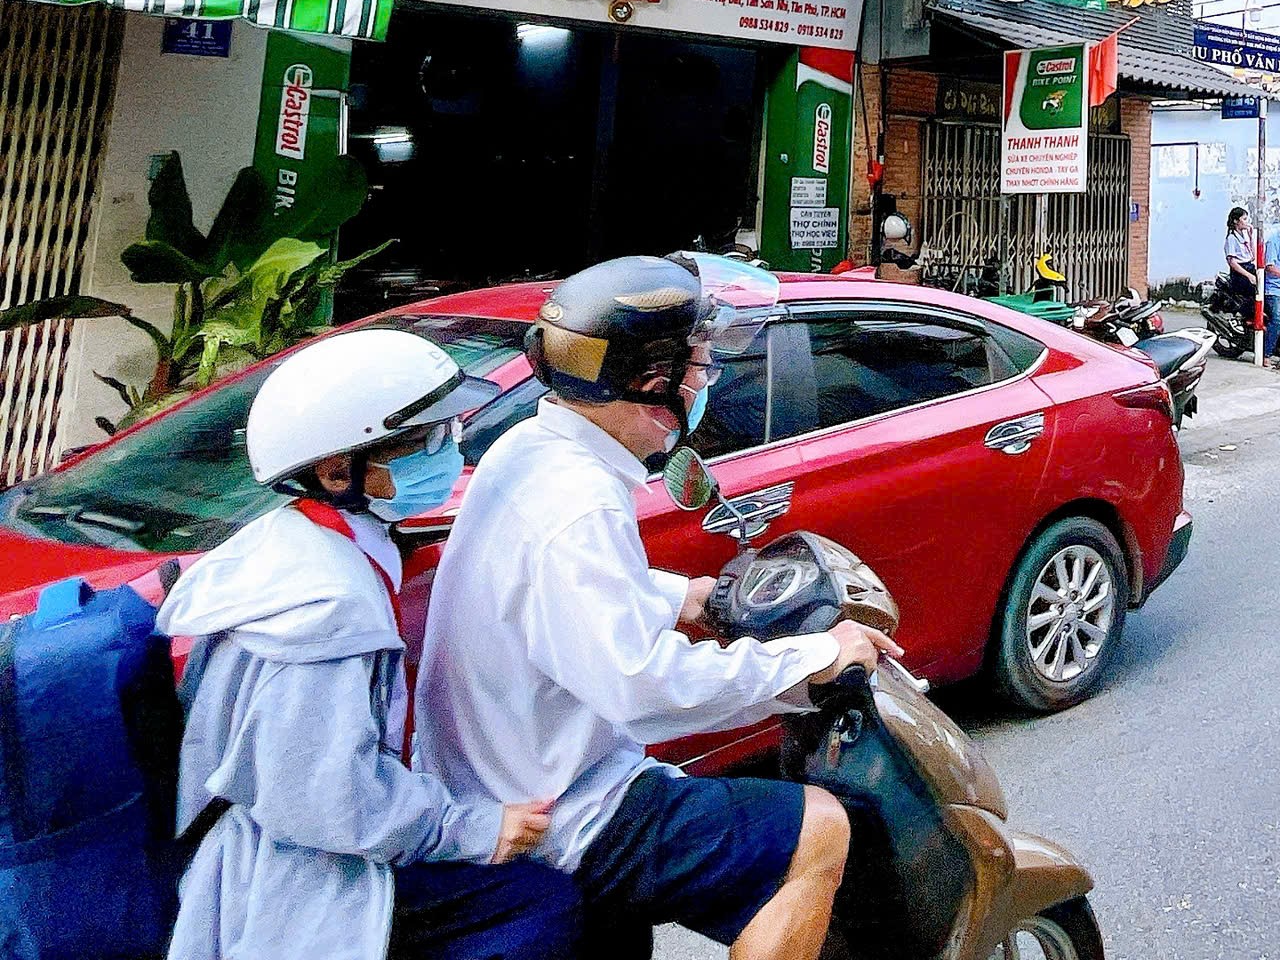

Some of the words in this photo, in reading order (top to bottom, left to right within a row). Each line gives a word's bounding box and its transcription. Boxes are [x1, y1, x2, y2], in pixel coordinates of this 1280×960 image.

[830, 7, 846, 19] HCM
[182, 21, 215, 40] 41
[739, 16, 758, 29] 0988
[758, 19, 773, 31] 534
[773, 21, 789, 33] 829
[797, 24, 814, 37] 0918
[814, 26, 828, 39] 534
[829, 28, 844, 40] 829
[1045, 60, 1072, 72] Castrol
[1212, 46, 1243, 65] PHỐ
[1245, 52, 1275, 70] VĂN
[1052, 75, 1077, 85] POINT
[280, 86, 308, 152] Castrol
[816, 120, 829, 168] Castrol
[1008, 137, 1041, 150] THANH
[1044, 135, 1079, 148] THANH
